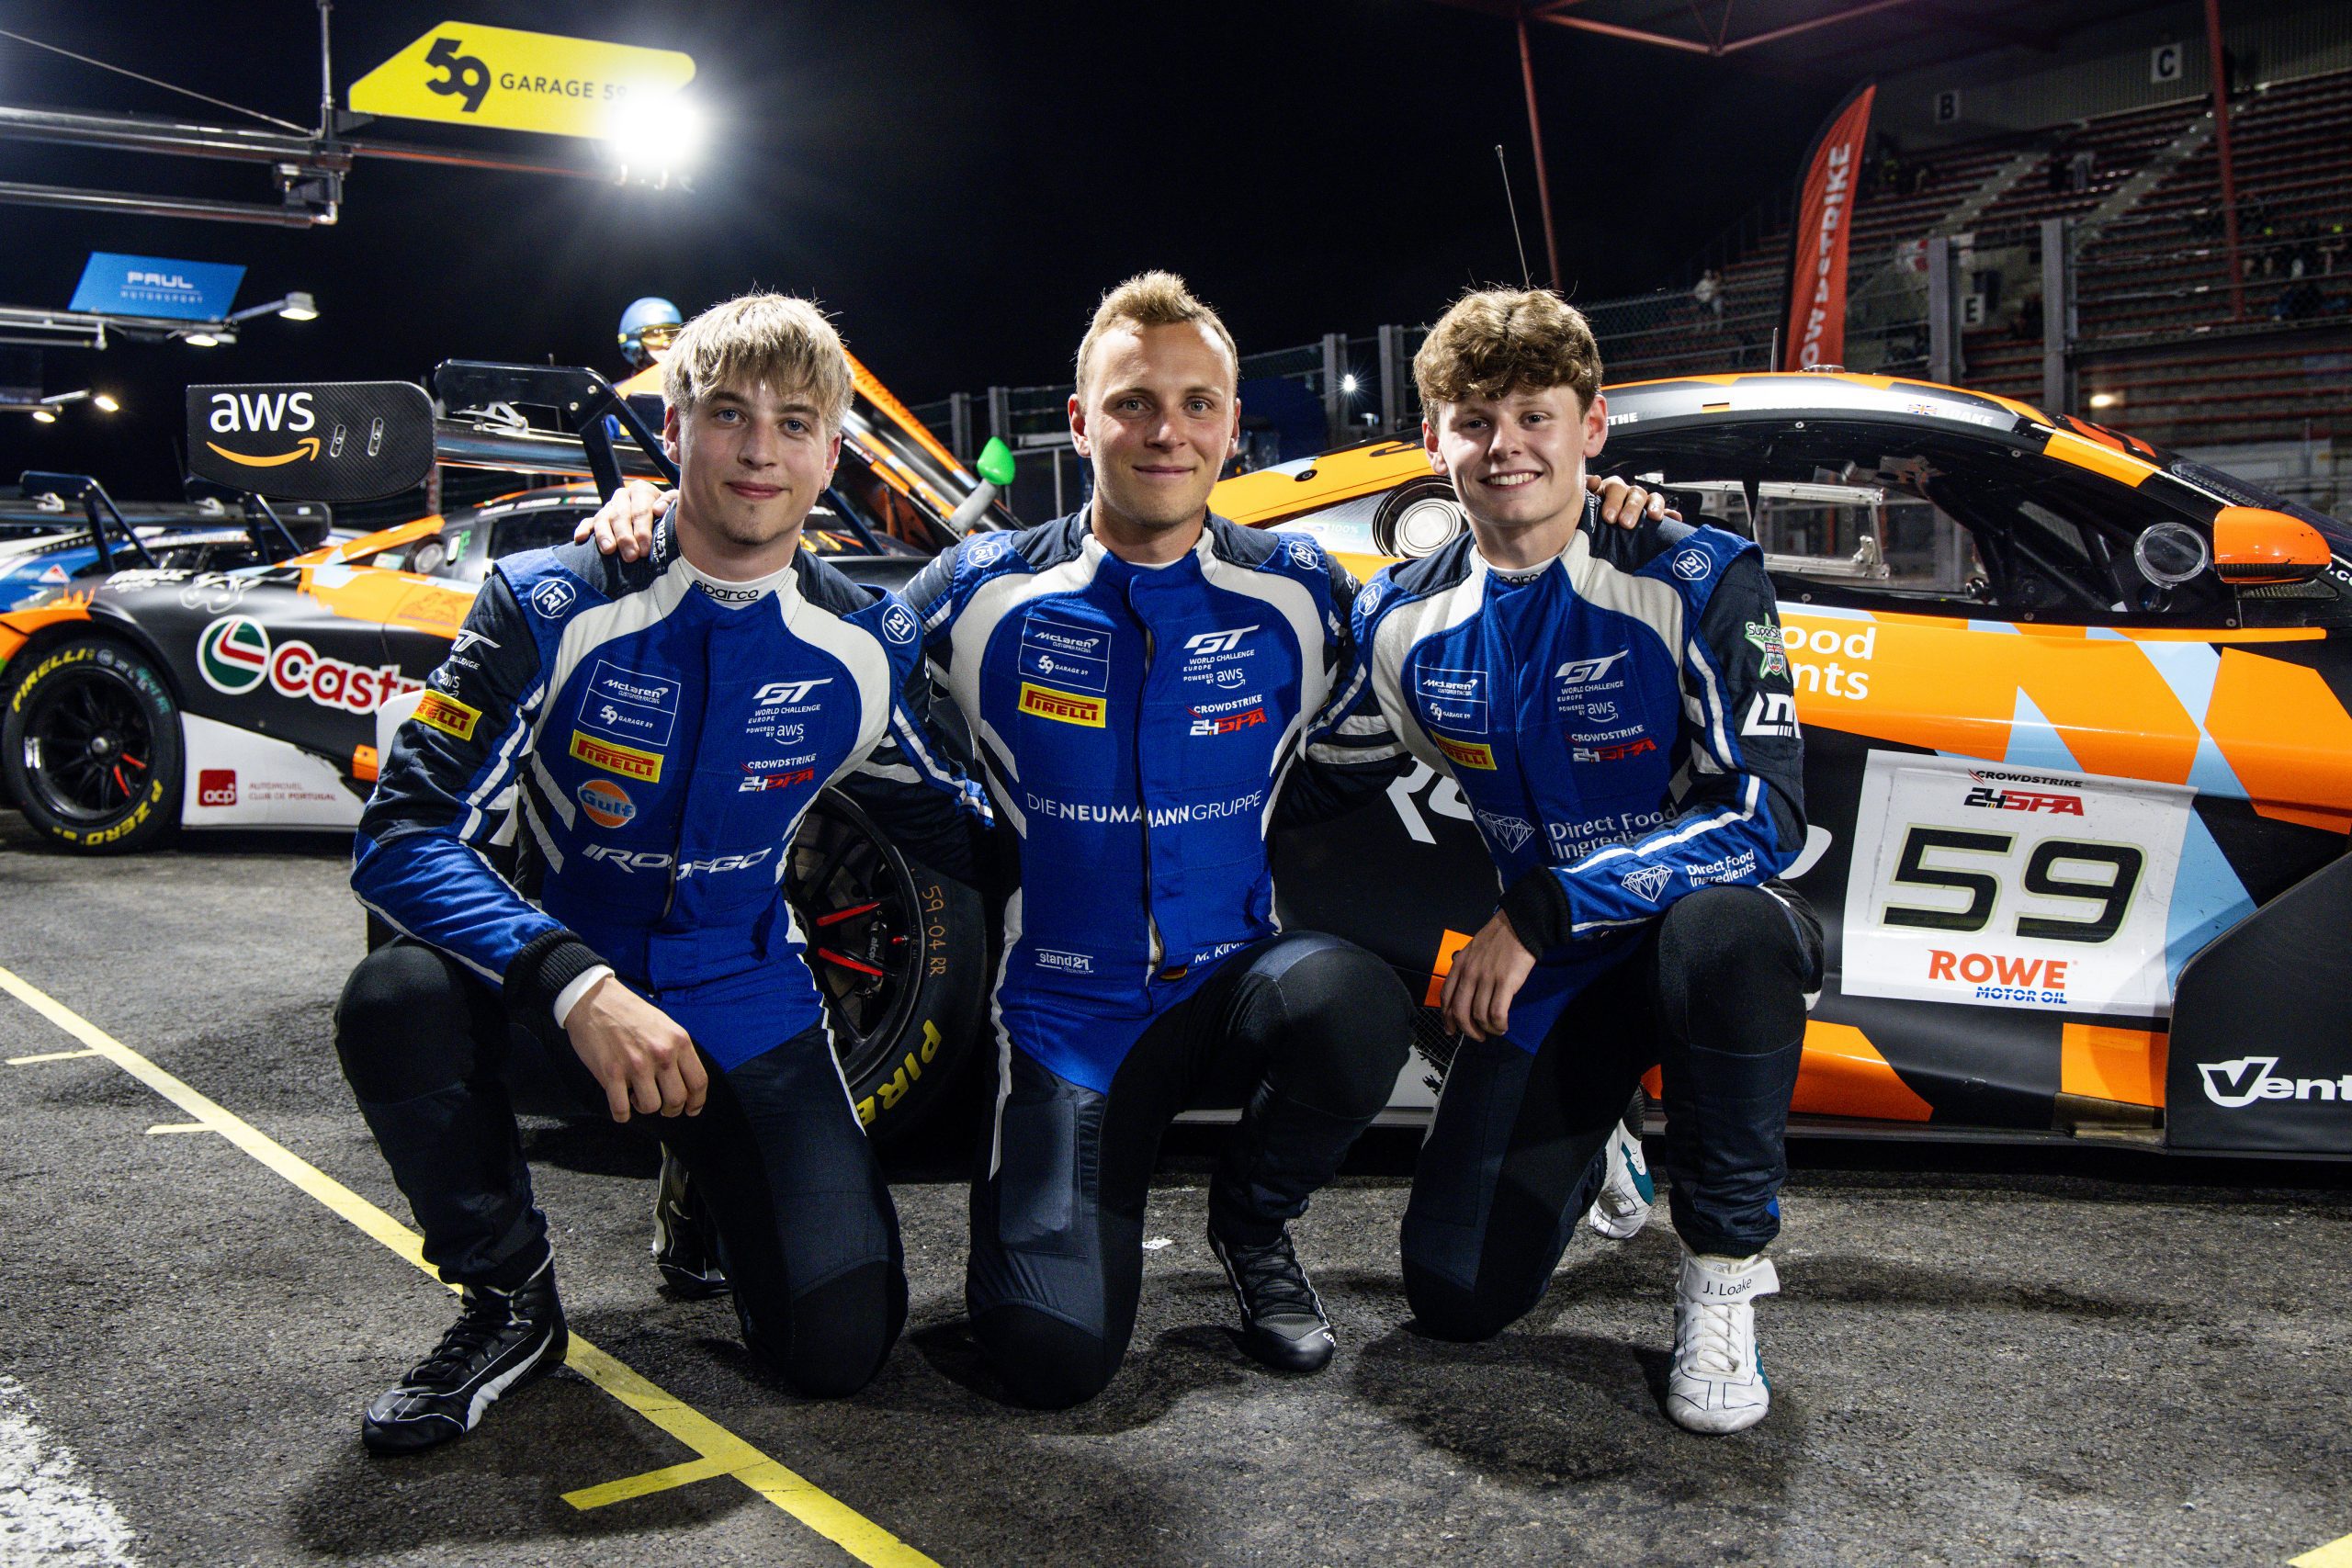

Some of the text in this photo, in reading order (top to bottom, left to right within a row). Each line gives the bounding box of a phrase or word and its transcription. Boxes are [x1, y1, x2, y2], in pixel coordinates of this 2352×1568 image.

[2159, 49, 2176, 77] C
[424, 38, 491, 113] 59
[500, 73, 594, 98] GARAGE
[1940, 95, 1955, 119] B
[127, 271, 194, 289] PAUL
[210, 392, 315, 433] aws
[1035, 632, 1091, 649] McLaren
[1038, 655, 1054, 674] 59
[1055, 664, 1080, 674] GARAGE
[1190, 649, 1255, 665] WORLD CHALLENGE
[1183, 664, 1212, 672] EUROPE
[1183, 668, 1243, 682] POWERED aws
[13, 648, 86, 714] PIRELLI
[603, 679, 661, 698] McLaren
[1422, 679, 1472, 691] McLaren
[1561, 681, 1624, 694] WORLD CHALLENGE
[1793, 661, 1870, 700] nts
[1024, 689, 1099, 722] PIRELLI
[1193, 694, 1262, 714] CROWDSTRIKE
[1556, 694, 1583, 703] EUROPE
[600, 705, 618, 725] 59
[618, 715, 645, 727] GARAGE
[755, 704, 821, 716] WORLD CHALLENGE
[1558, 702, 1616, 715] POWERED aws
[748, 716, 775, 724] EUROPE
[746, 723, 805, 737] POWERED aws
[1571, 724, 1645, 742] CROWDSTRIKE
[576, 739, 655, 777] PIRELLI
[747, 753, 817, 770] CROWDSTRIKE
[1974, 770, 2084, 788] CROWDSTRIKE
[580, 789, 634, 818] Gulf
[1549, 802, 1679, 841] Direct Food
[1685, 848, 1755, 875] Direct Food
[1880, 824, 2146, 947] 59
[1039, 953, 1090, 971] stand21
[1927, 949, 2068, 990] ROWE
[1975, 986, 2068, 1005] MOTOR OIL
[856, 1019, 942, 1127] PIRE
[1702, 1278, 1752, 1296] J. Loake
